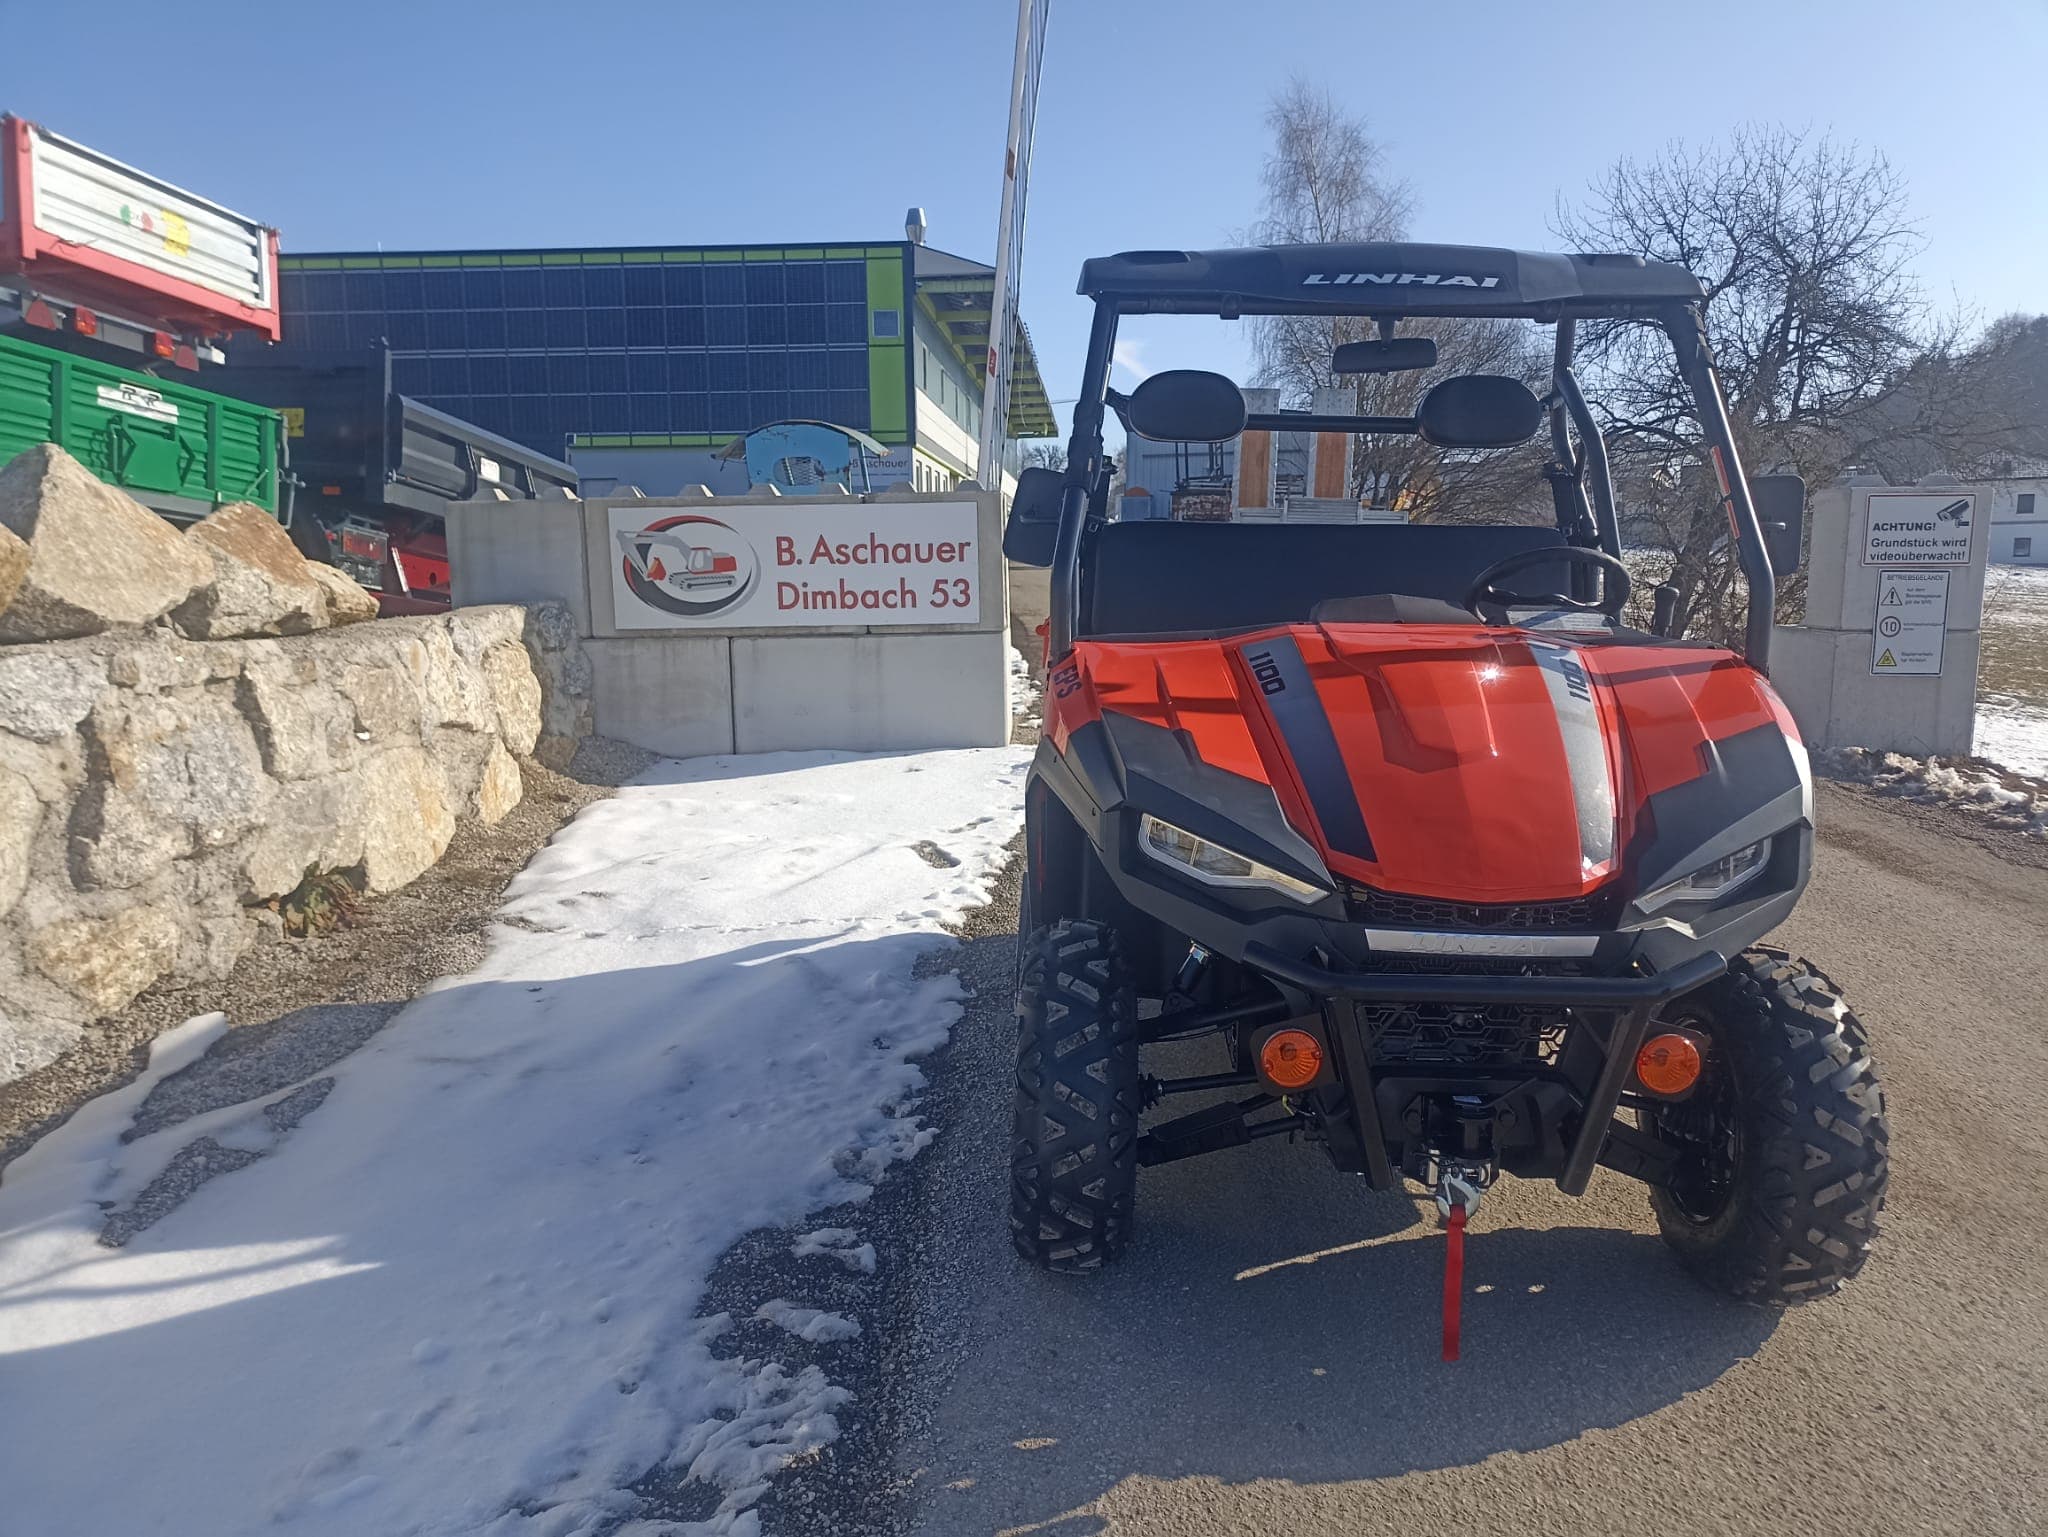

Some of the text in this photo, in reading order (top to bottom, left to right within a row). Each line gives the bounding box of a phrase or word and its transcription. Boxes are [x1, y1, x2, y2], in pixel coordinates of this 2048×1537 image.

[1302, 273, 1500, 288] LINHAI
[1872, 522, 1937, 532] ACHTUNG!
[776, 532, 972, 566] B. Aschauer
[1871, 537, 1968, 548] Grundstück wird
[777, 577, 972, 610] Dimbach 53
[1884, 621, 1898, 633] 10
[1053, 664, 1083, 699] EPS
[1249, 651, 1287, 696] 1100
